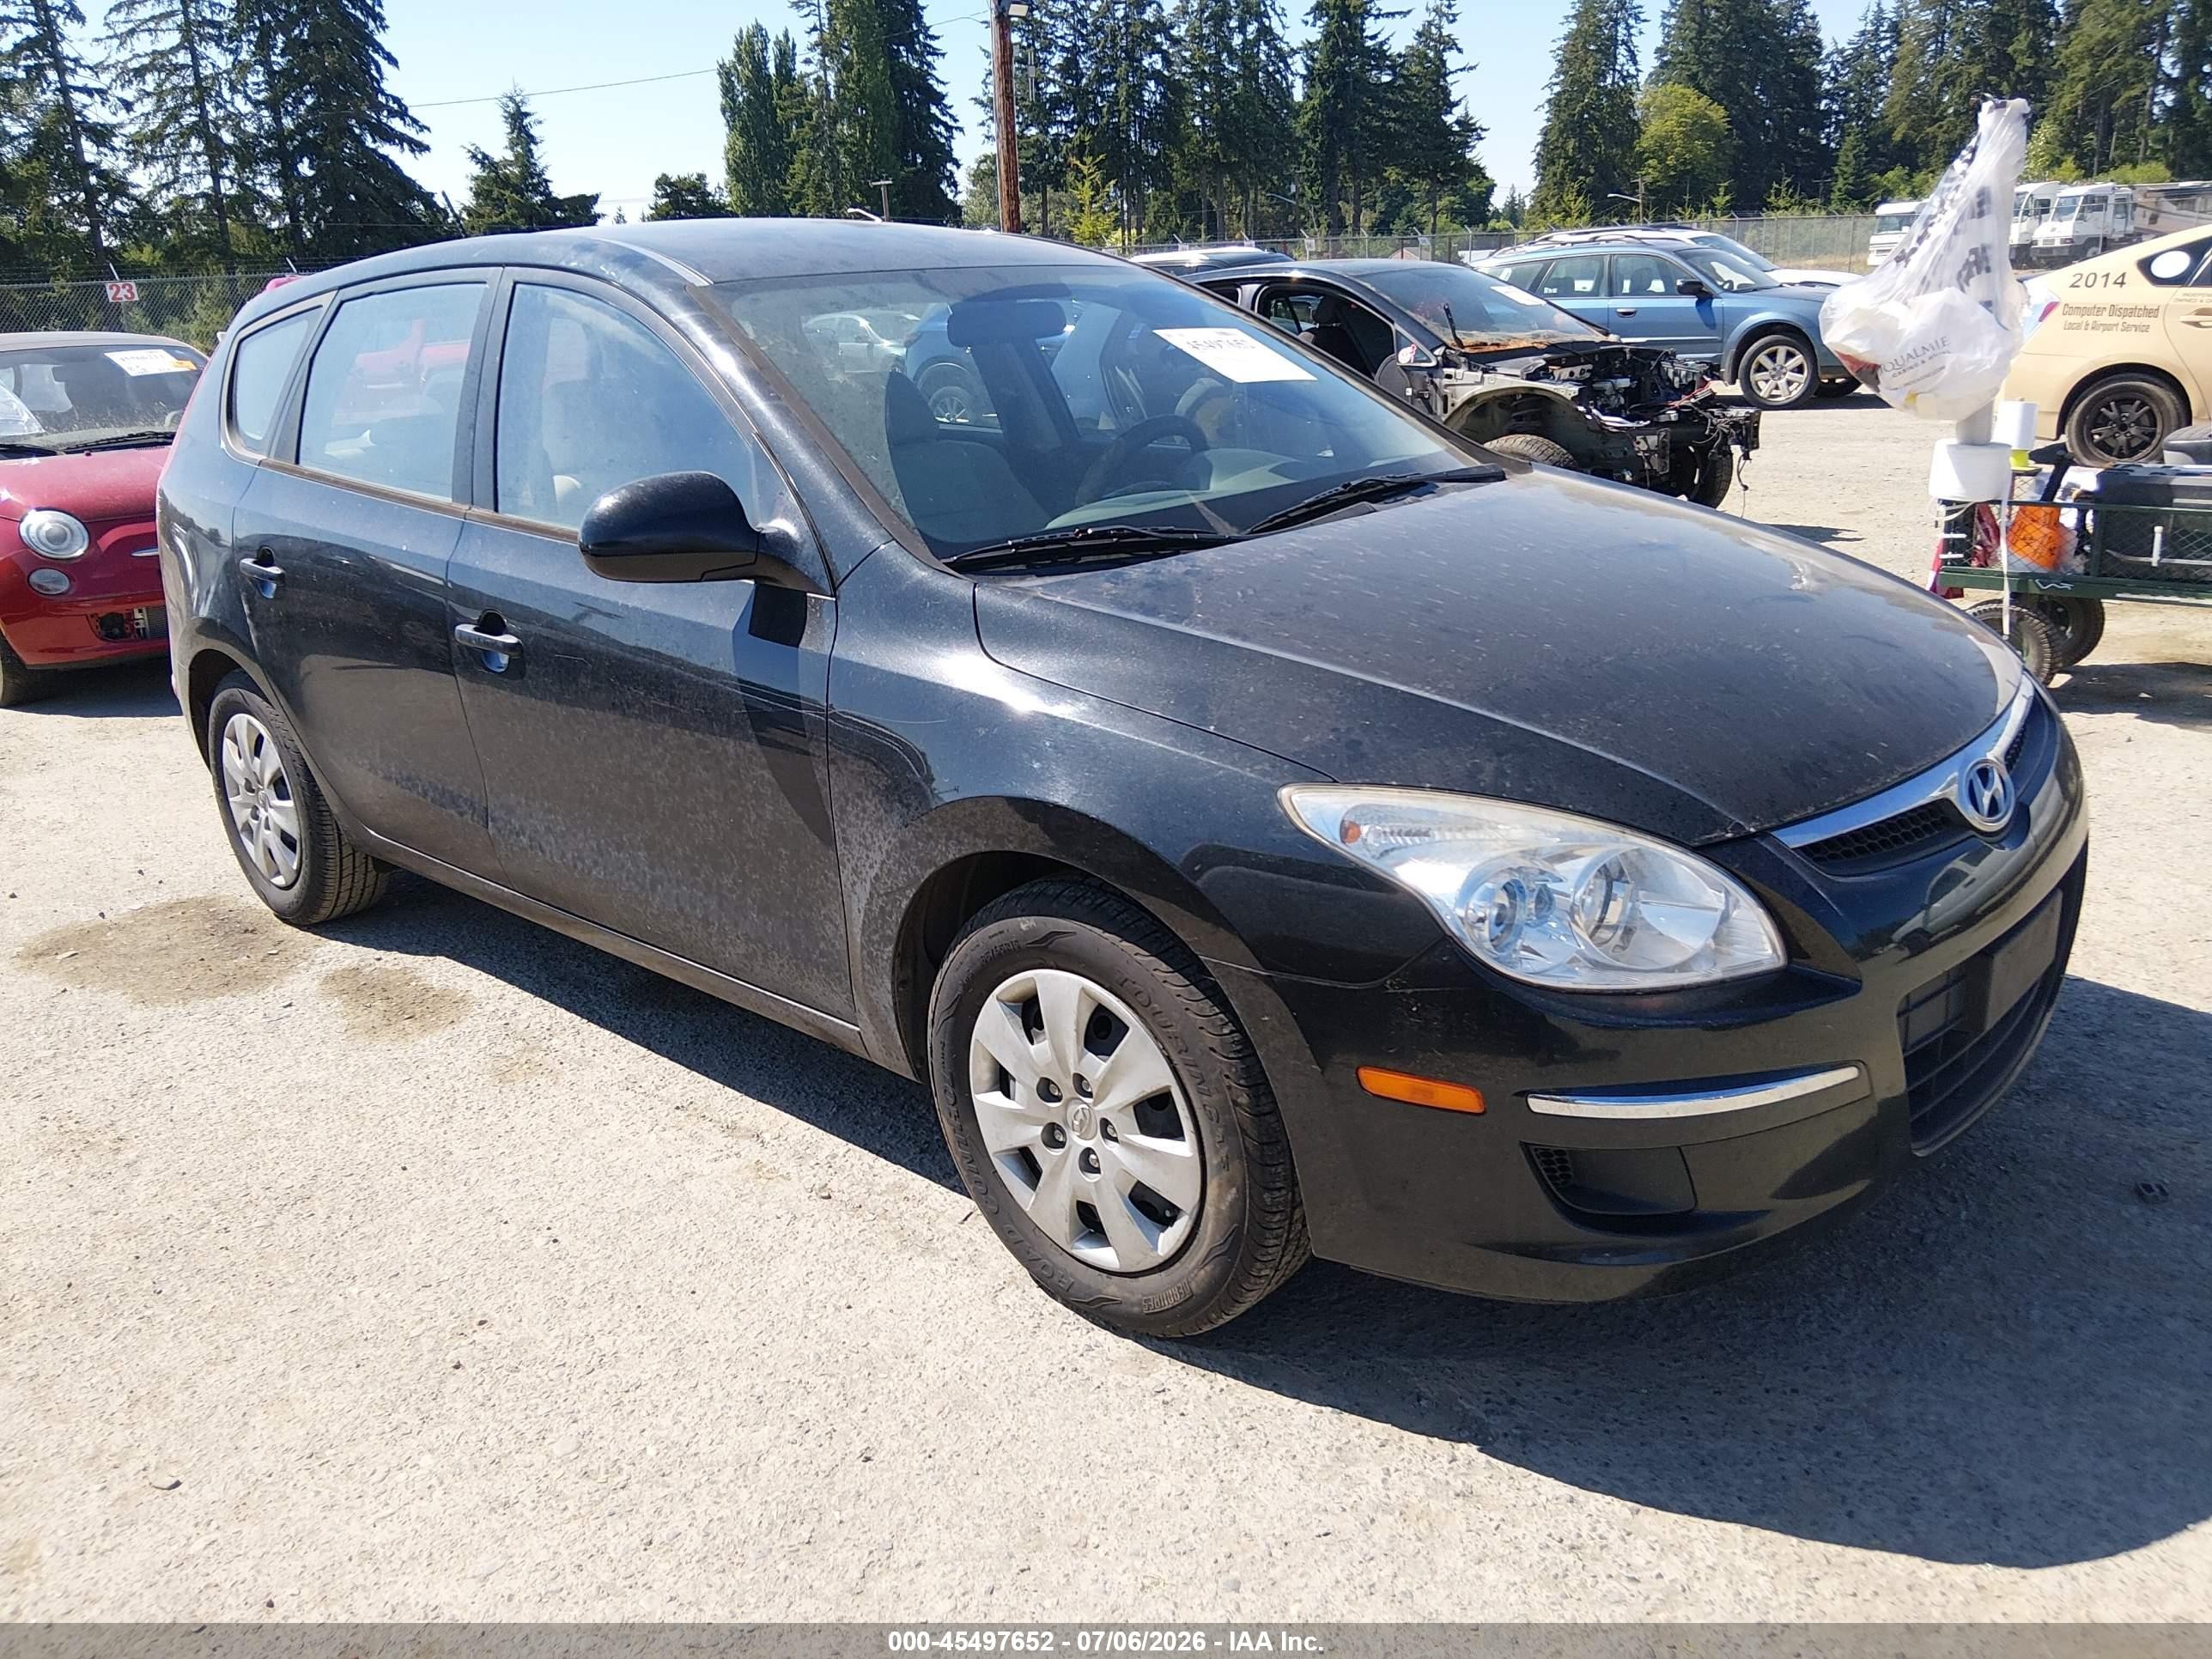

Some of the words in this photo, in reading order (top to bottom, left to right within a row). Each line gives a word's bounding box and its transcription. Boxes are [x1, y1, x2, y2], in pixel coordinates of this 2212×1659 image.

[2069, 271, 2127, 289] 2014
[109, 283, 135, 301] 23
[2062, 303, 2106, 318] Computer
[2108, 304, 2160, 319] Dispatched
[2063, 320, 2082, 331] Local
[2090, 321, 2119, 333] Airport
[2121, 321, 2151, 333] Service
